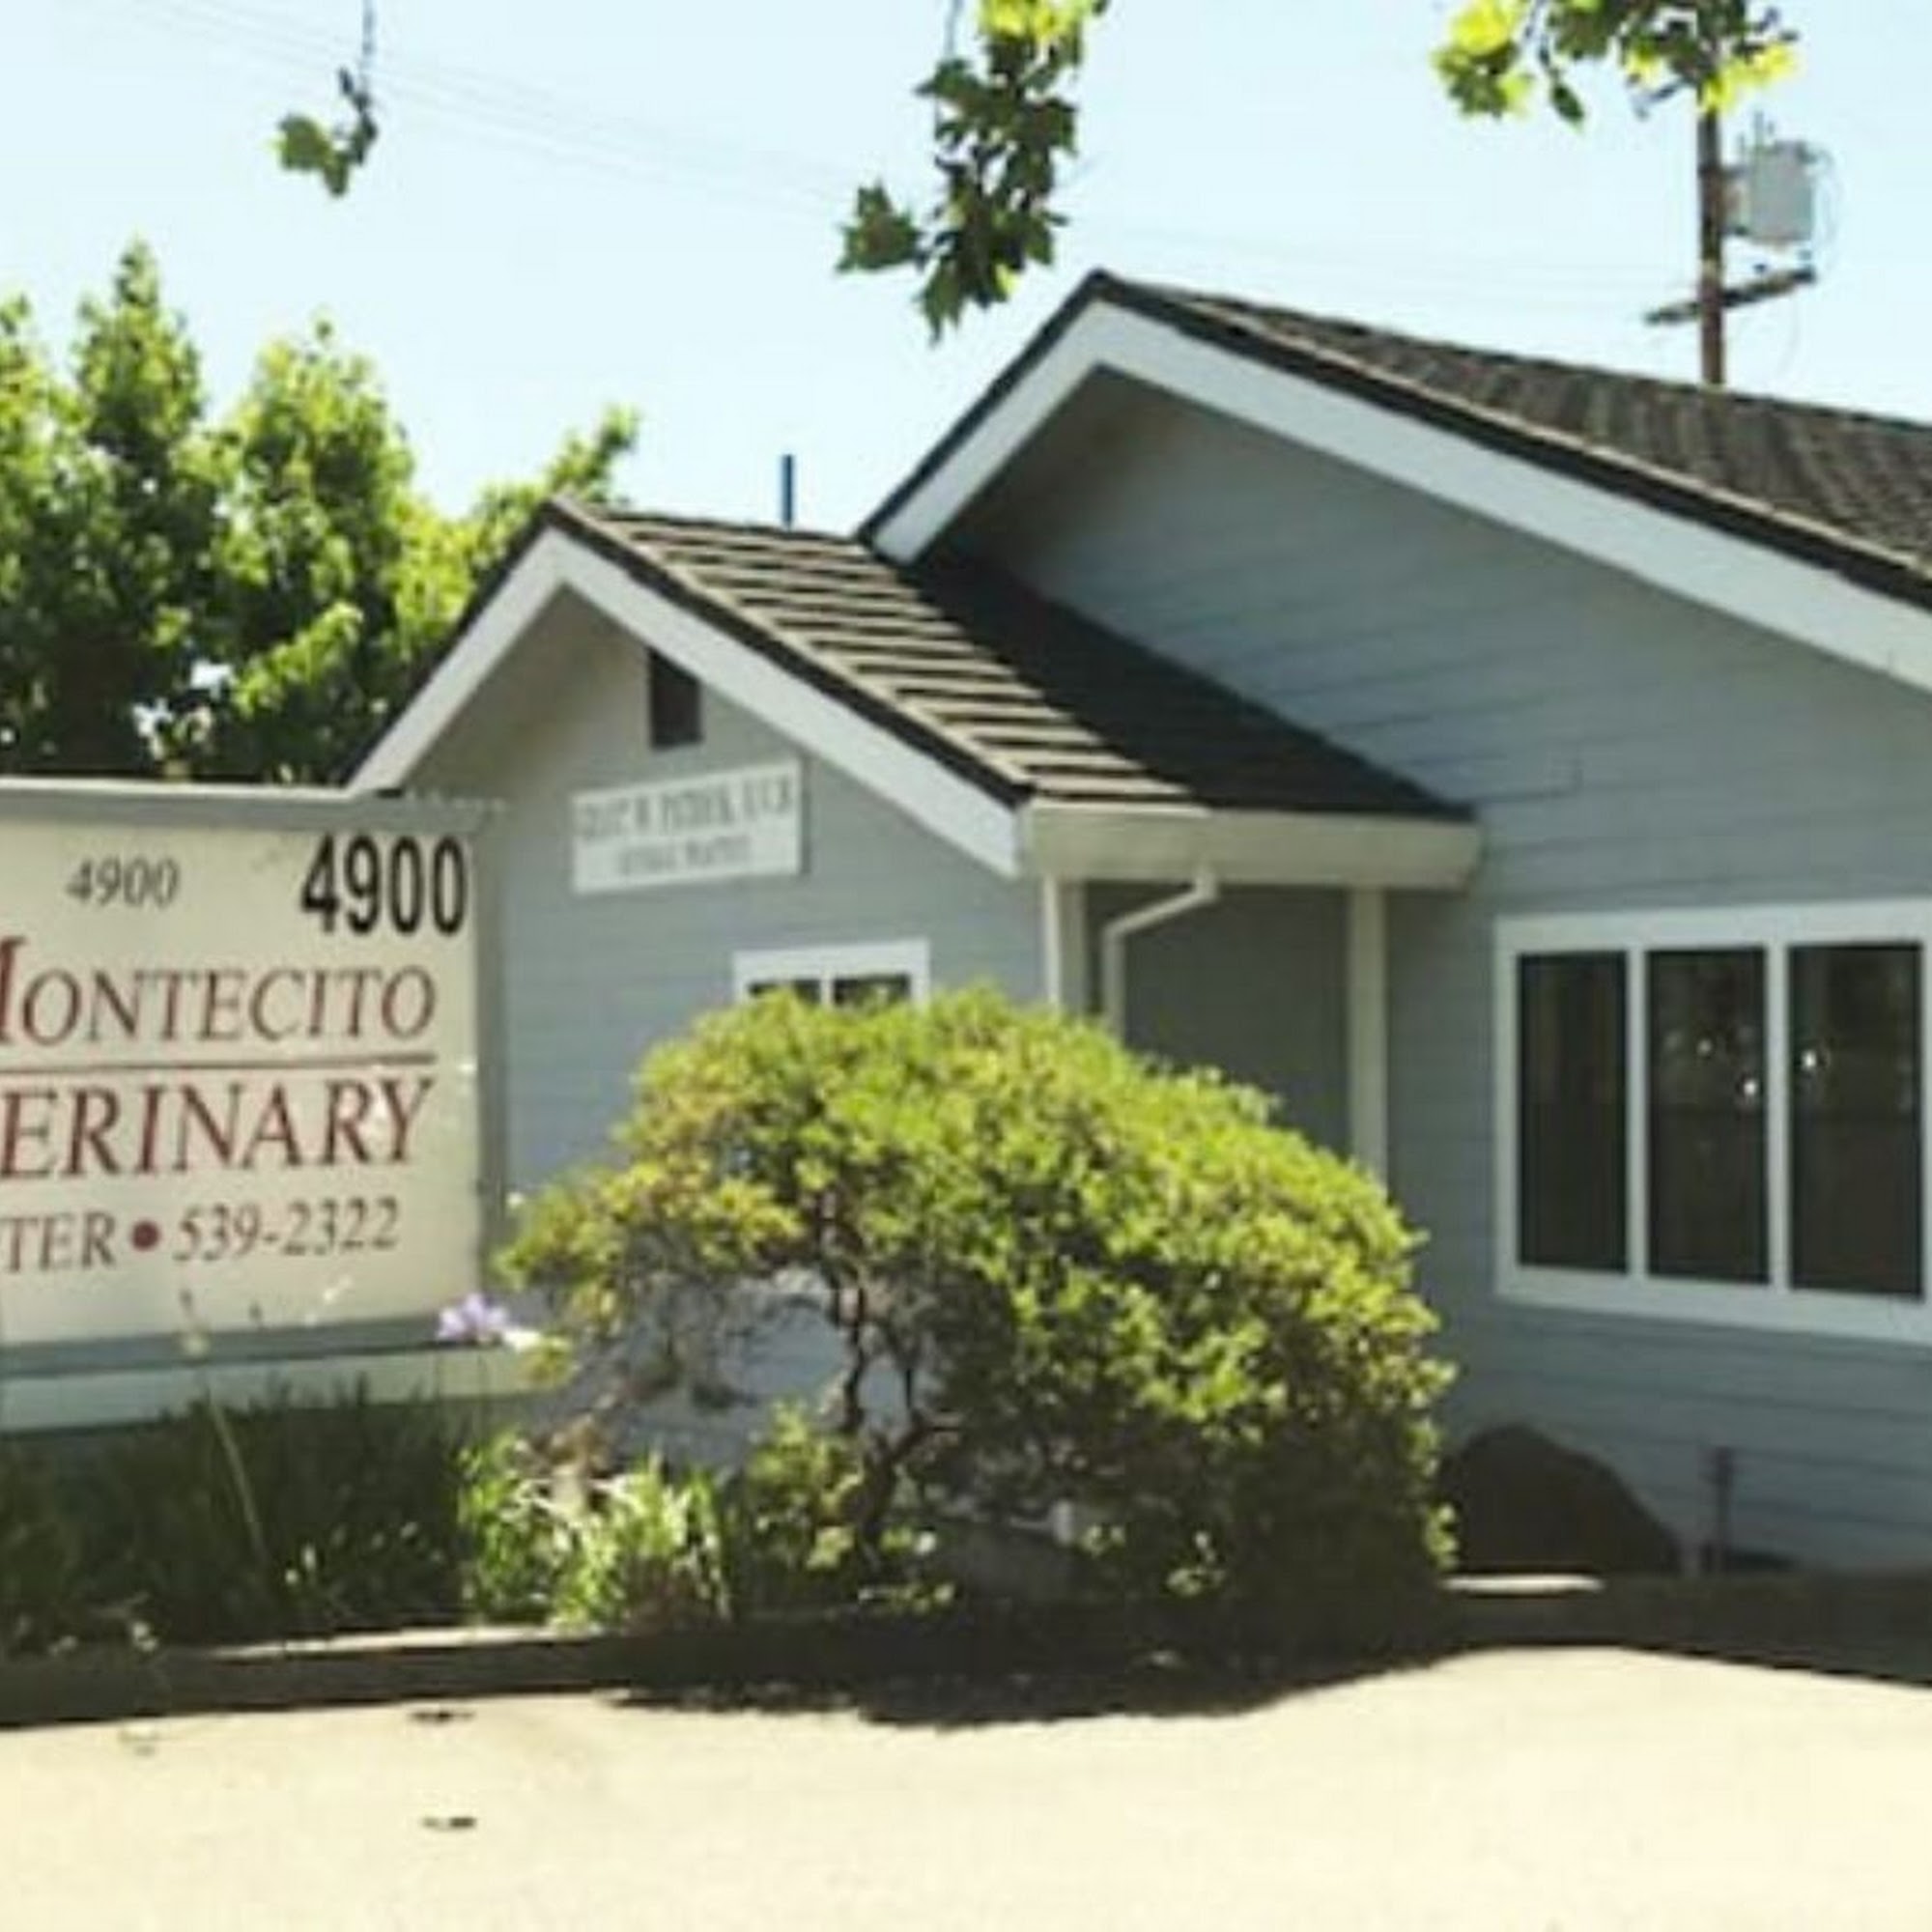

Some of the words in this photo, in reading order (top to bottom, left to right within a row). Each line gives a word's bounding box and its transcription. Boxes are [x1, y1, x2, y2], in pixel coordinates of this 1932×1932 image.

[67, 856, 181, 908] 4900
[301, 834, 469, 936] 4900
[0, 935, 436, 1045] ONTECITO
[173, 1196, 400, 1262] 539-2322
